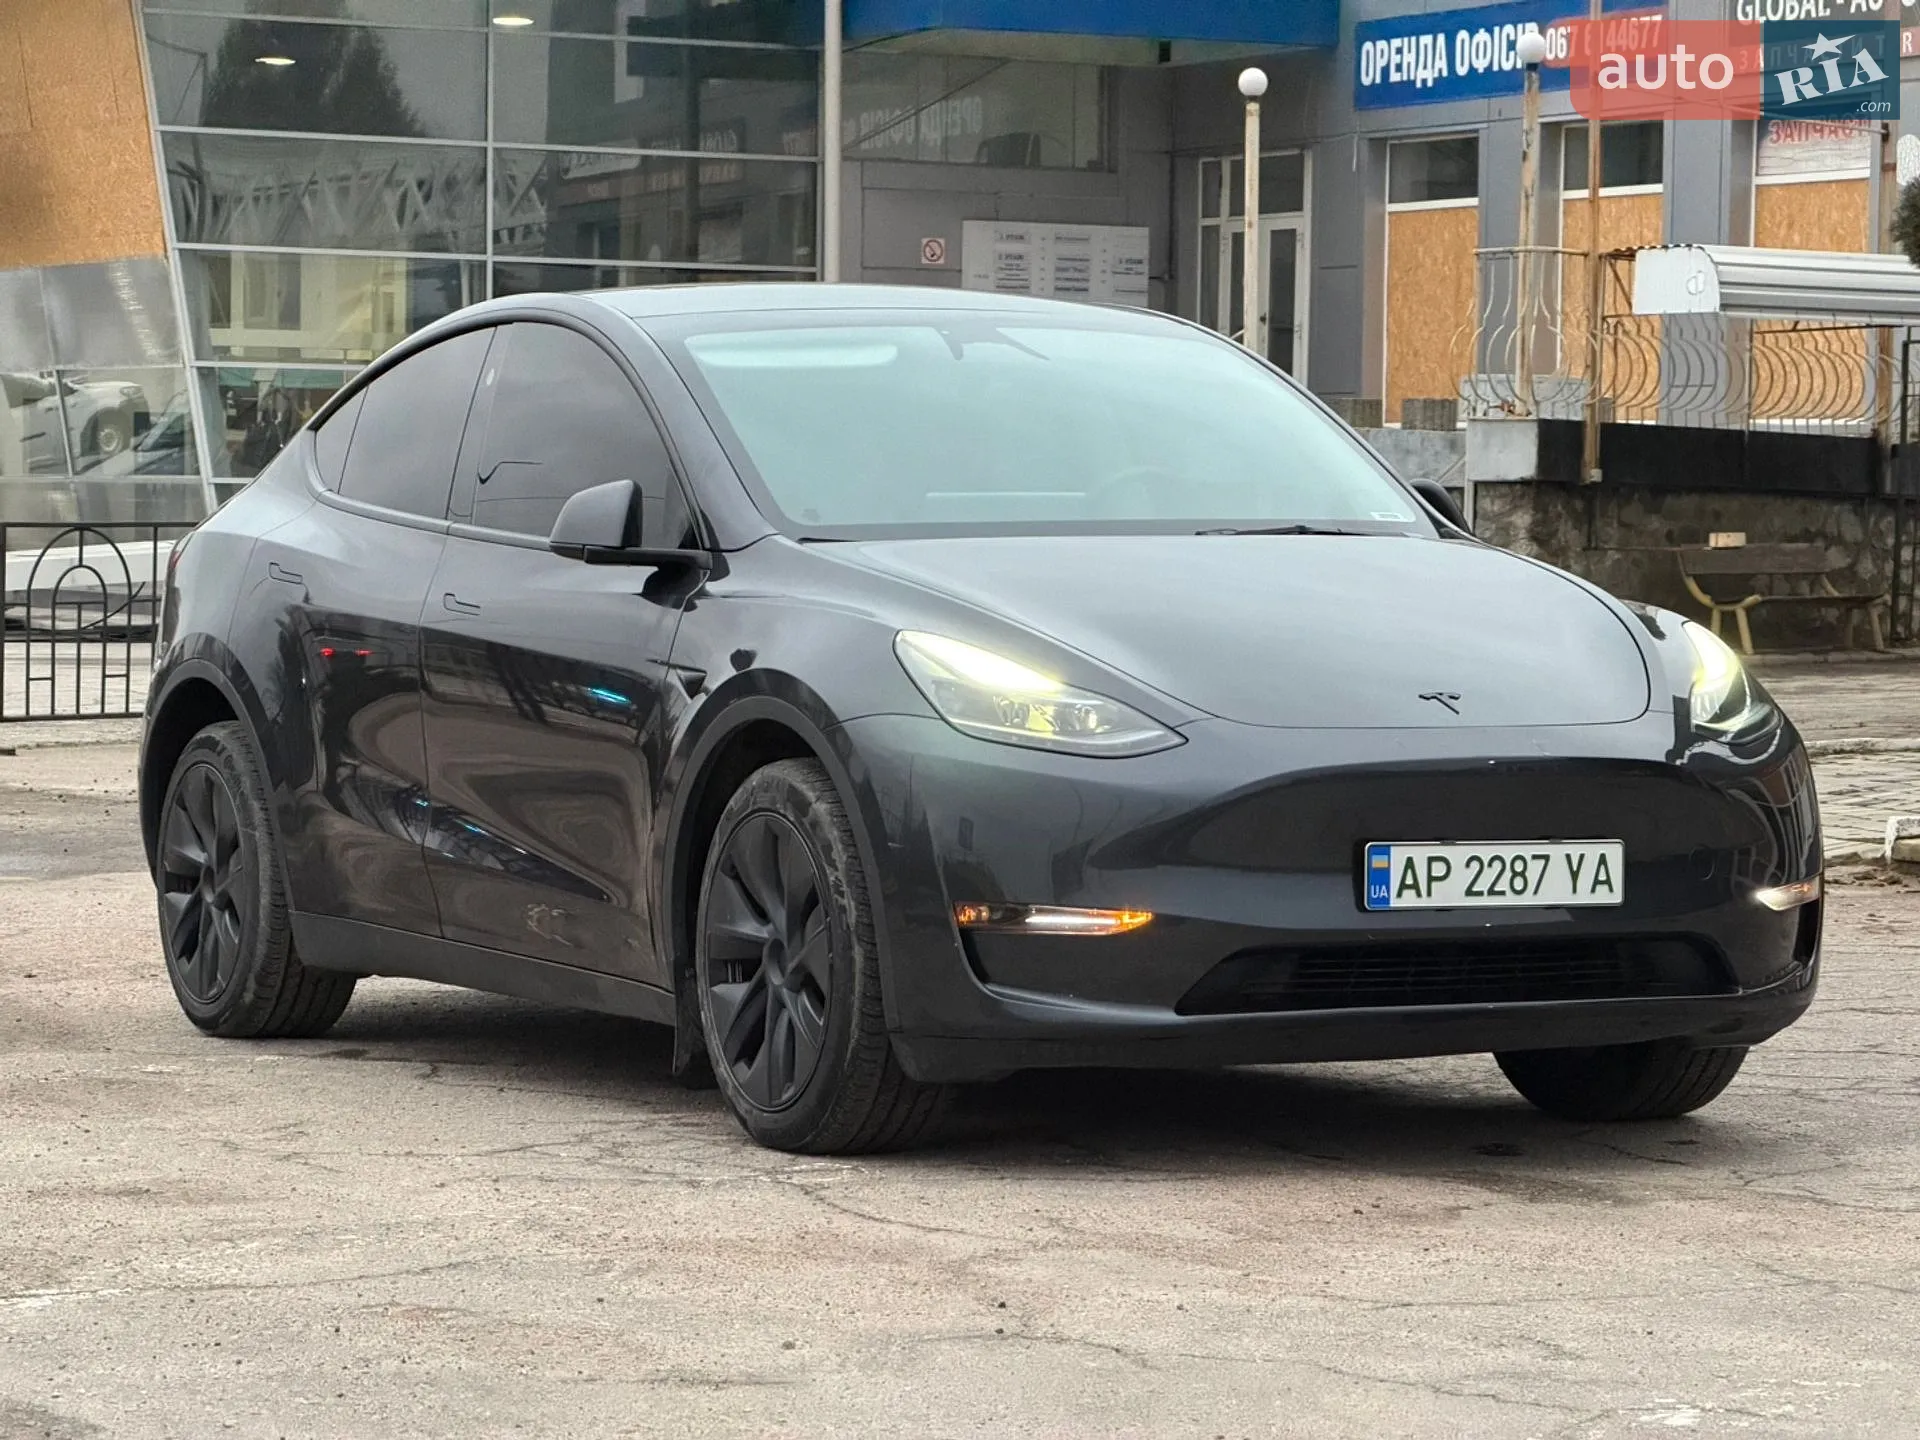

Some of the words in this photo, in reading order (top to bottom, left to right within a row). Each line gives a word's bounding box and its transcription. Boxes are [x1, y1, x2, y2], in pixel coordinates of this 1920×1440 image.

[1736, 0, 1831, 26] GLOBAL
[1360, 32, 1449, 89] ОРЕНДА
[1545, 24, 1579, 61] 067
[1738, 36, 1863, 71] ЗАПЧАИ
[1370, 884, 1389, 899] UA
[1395, 855, 1451, 898] AP
[1464, 853, 1551, 898] 2287
[1565, 852, 1614, 895] YA
